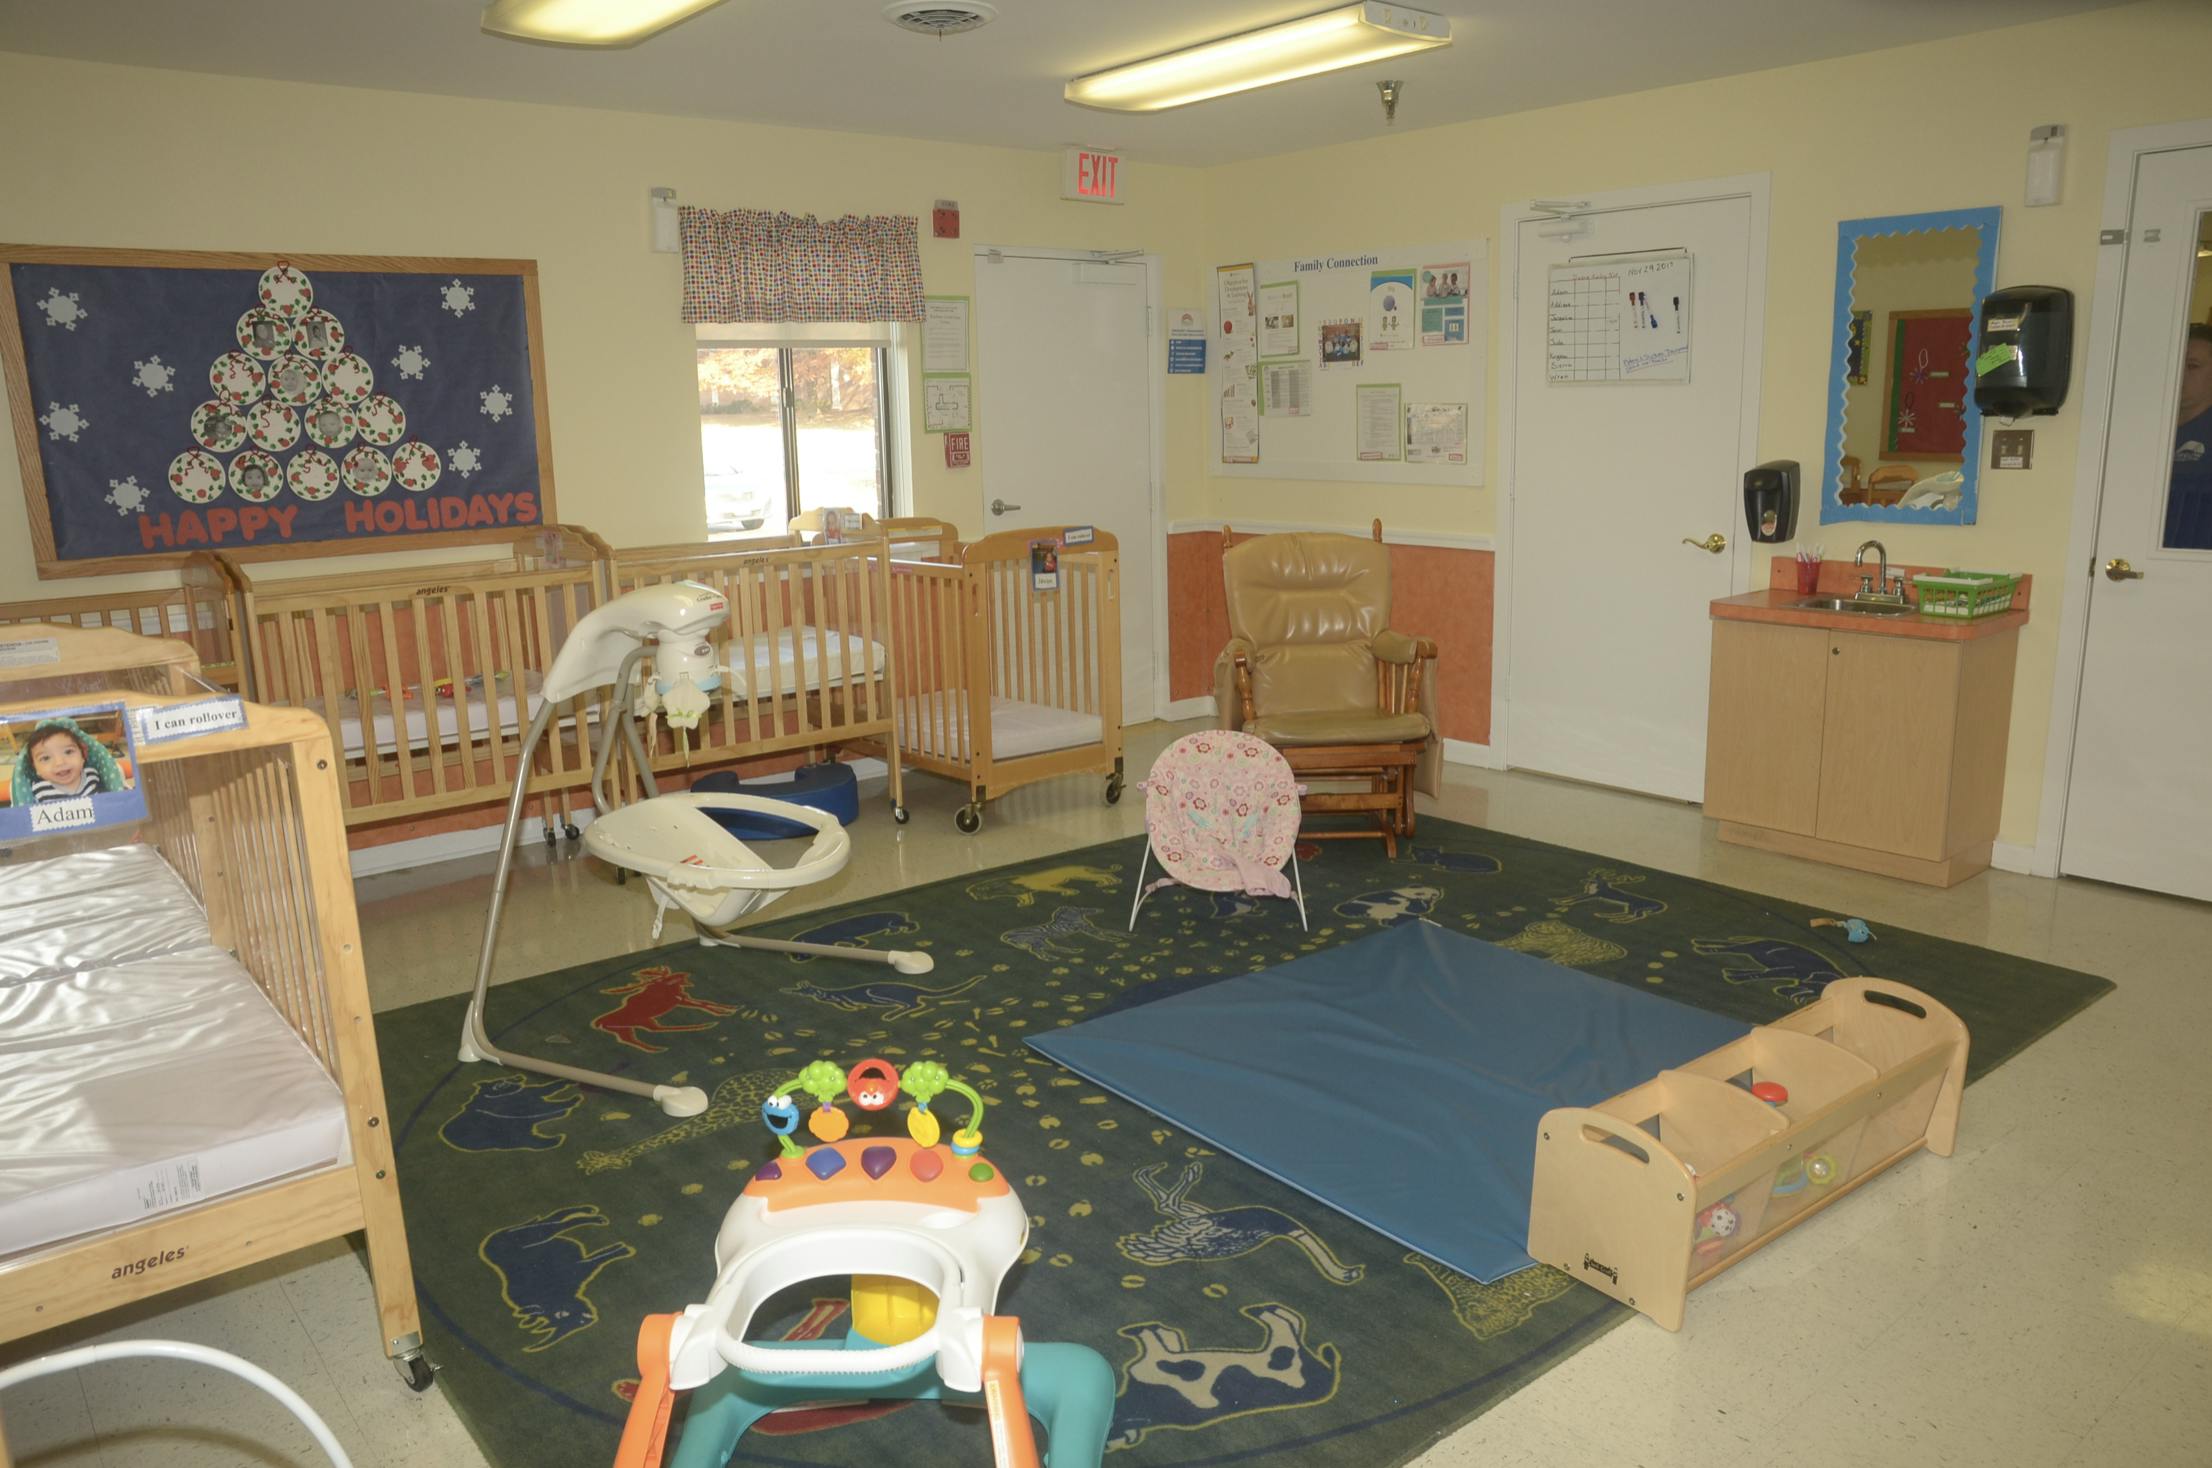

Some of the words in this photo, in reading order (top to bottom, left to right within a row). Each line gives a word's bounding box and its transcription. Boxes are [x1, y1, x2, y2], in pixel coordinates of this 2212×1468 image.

[1078, 152, 1119, 200] EXIT
[1294, 259, 1323, 273] Family
[1327, 254, 1378, 270] Connection
[952, 437, 969, 451] FIRE
[138, 505, 298, 550] HAPPY
[344, 492, 538, 533] HOLIDAYS
[416, 585, 449, 596] angeles
[155, 720, 160, 730] I
[164, 719, 185, 729] can
[190, 710, 237, 725] rollover
[37, 806, 93, 825] Adam
[111, 1247, 185, 1279] angeles
